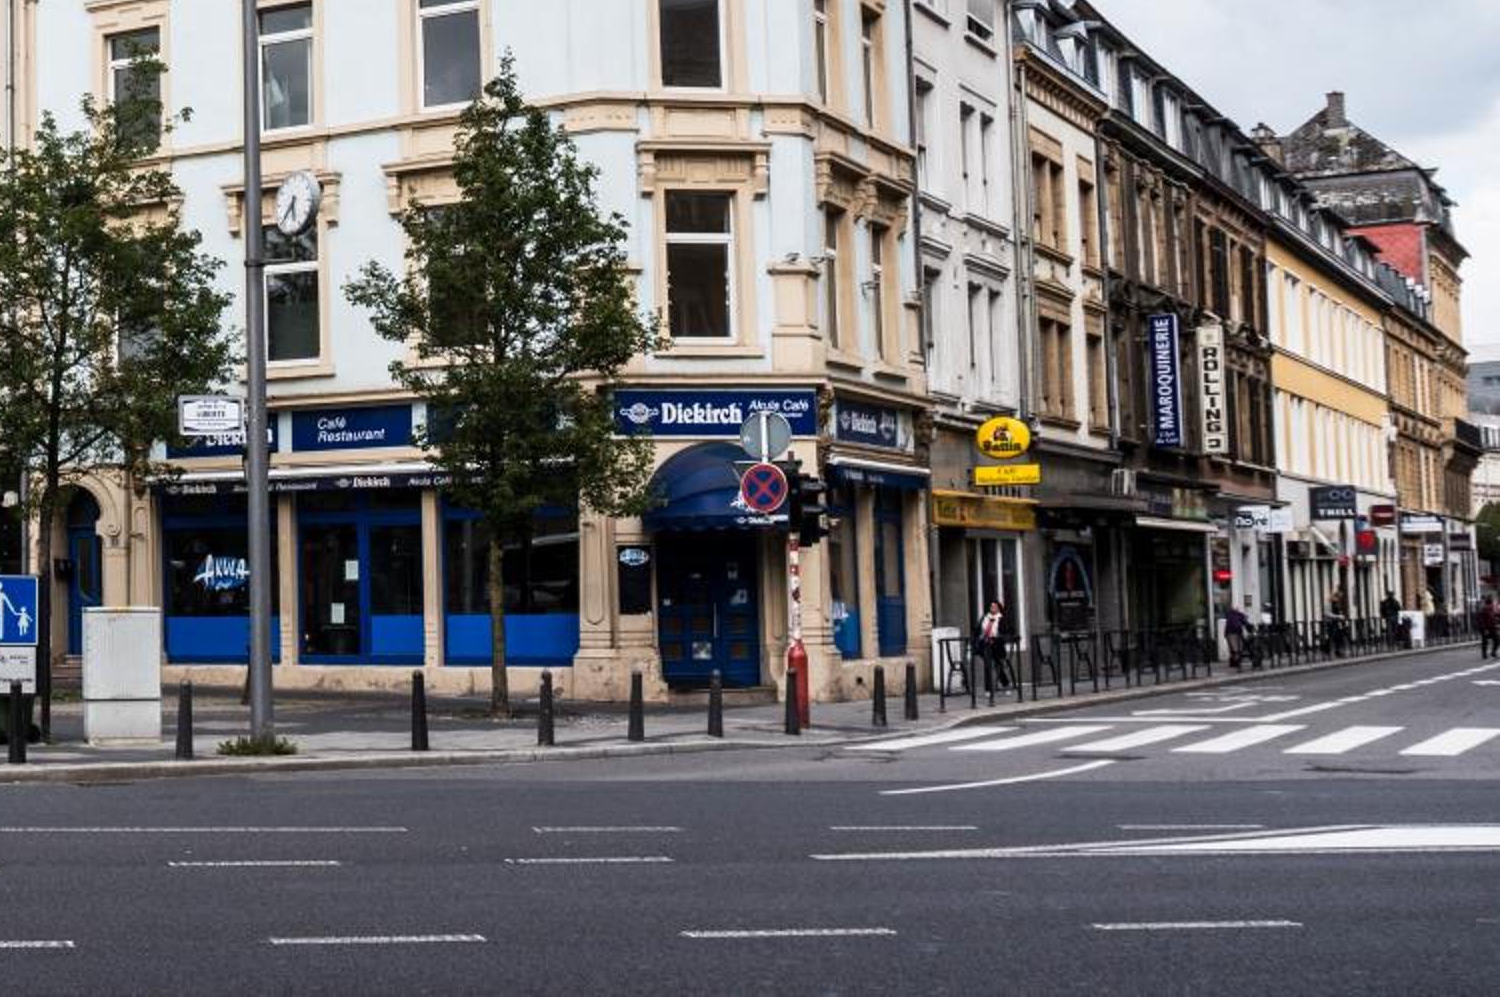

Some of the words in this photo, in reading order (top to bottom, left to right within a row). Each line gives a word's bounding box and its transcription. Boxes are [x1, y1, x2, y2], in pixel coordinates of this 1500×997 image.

[1155, 319, 1175, 429] MAROQUINERIE
[1202, 347, 1222, 433] ROLLING
[317, 416, 347, 430] Café
[661, 402, 743, 424] Diekirch
[783, 399, 809, 412] Café
[317, 428, 385, 443] Restaurant
